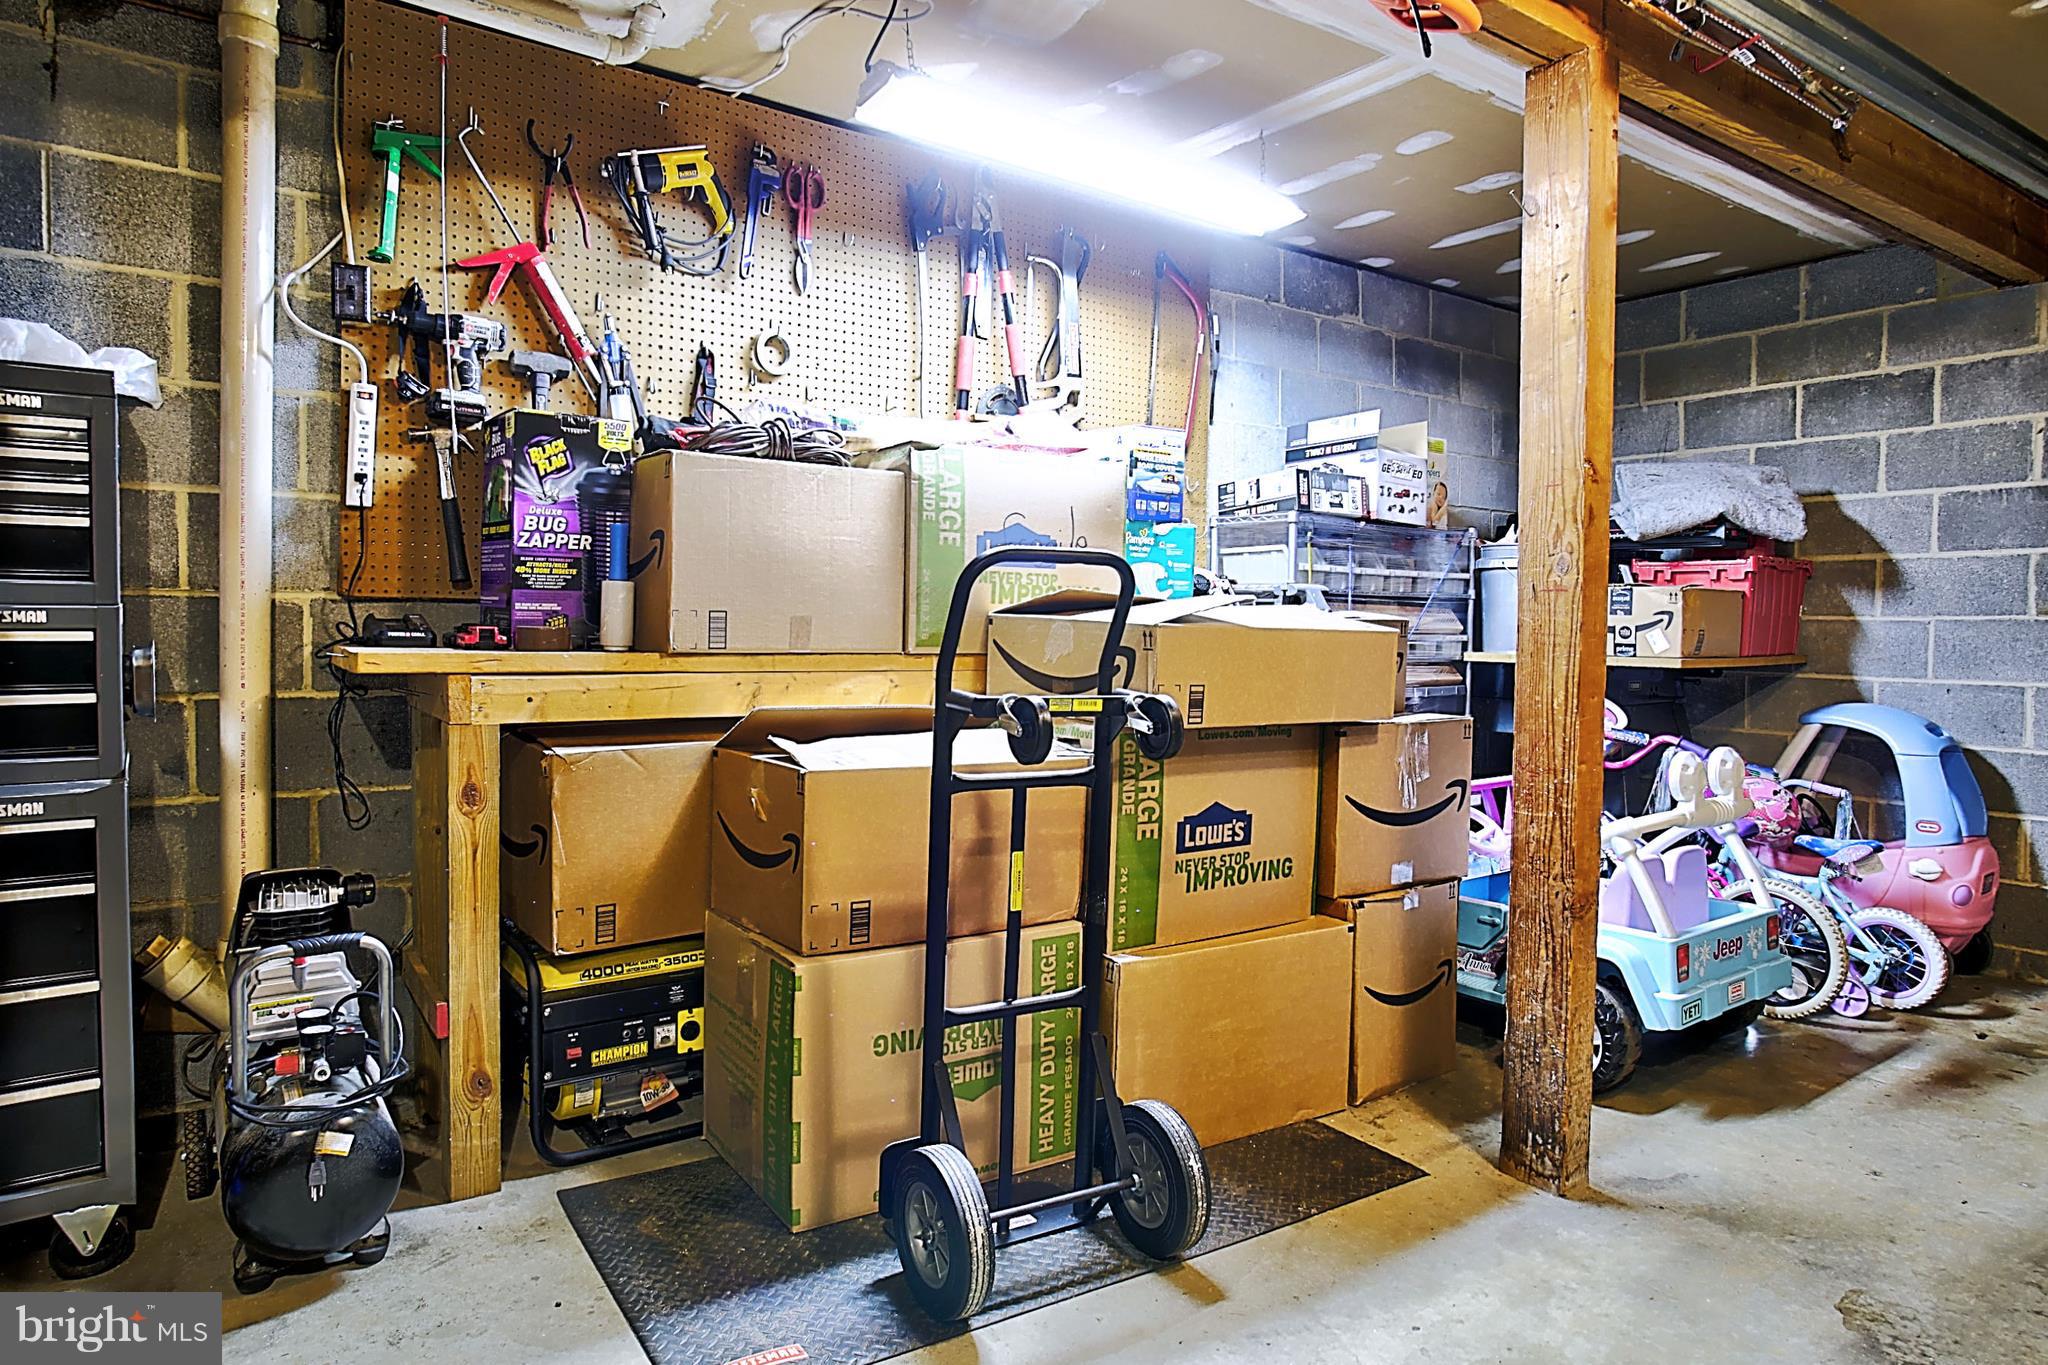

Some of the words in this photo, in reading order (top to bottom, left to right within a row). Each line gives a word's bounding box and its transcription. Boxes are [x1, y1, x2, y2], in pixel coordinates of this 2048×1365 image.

[604, 422, 627, 431] 5500
[528, 437, 567, 464] BLACK
[538, 452, 567, 476] FLAG
[922, 453, 936, 521] GRANDE
[529, 506, 563, 516] Deluxe
[938, 453, 962, 548] LARGE
[523, 515, 567, 533] BUG
[516, 531, 593, 551] ZAPPER
[1126, 531, 1155, 547] Pampers
[980, 570, 1023, 585] NEVER
[1026, 572, 1059, 586] STOP
[1197, 725, 1293, 741] Lowes.com/Moving
[1121, 739, 1138, 816] GRANDE
[1136, 752, 1161, 841] ARGE
[1184, 819, 1247, 848] LOWE'S
[1175, 856, 1217, 874] NEVER
[1220, 851, 1251, 868] STOP
[1119, 867, 1129, 883] 24
[1186, 857, 1293, 893] IMPROVING
[1118, 899, 1128, 914] 18
[1117, 930, 1127, 944] 18
[1713, 935, 1743, 960] Jeep
[1067, 940, 1075, 956] 18
[664, 953, 699, 967] 3500
[1457, 951, 1492, 971] Anna
[581, 963, 625, 980] 4000
[1067, 973, 1075, 986] 18
[770, 968, 784, 1048] LARGE
[1683, 1002, 1700, 1021] YETI
[873, 1018, 1004, 1057] IMPRVING
[972, 1033, 1003, 1050] EVER
[591, 1041, 649, 1064] CHAMPION
[1040, 1020, 1057, 1077] DUTY
[1065, 1035, 1074, 1089] PESADO
[1039, 1083, 1056, 1154] HEAVY
[1063, 1092, 1073, 1146] GRANDE
